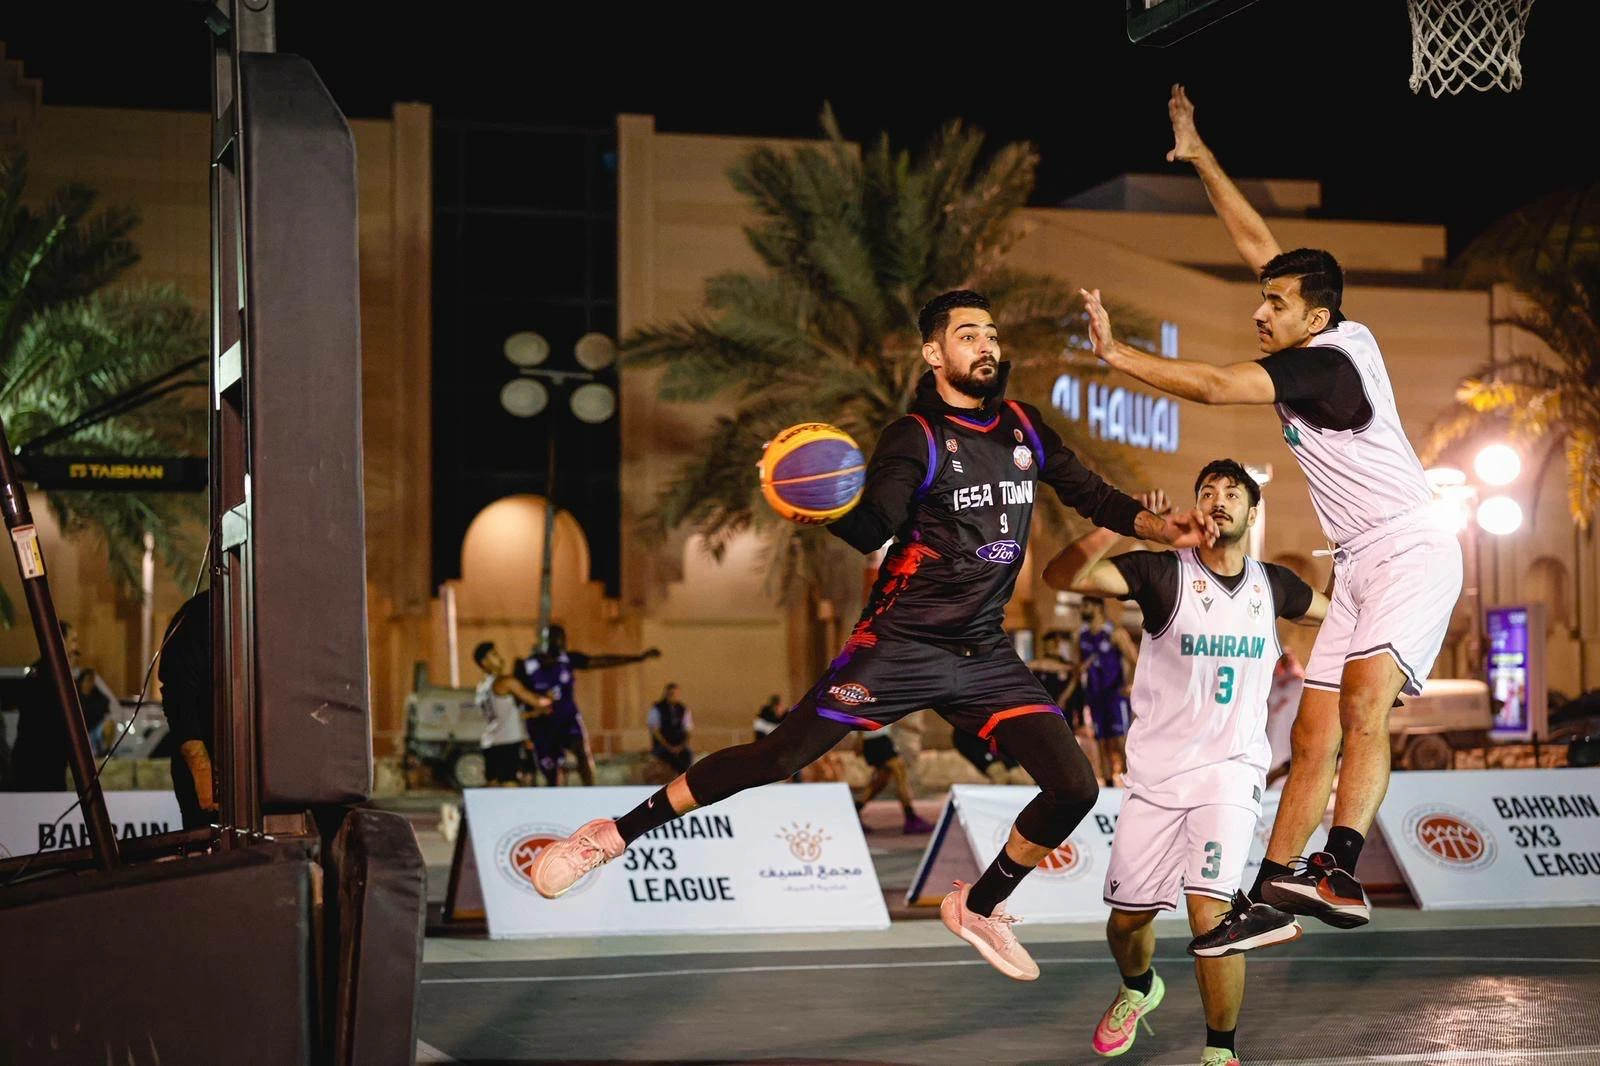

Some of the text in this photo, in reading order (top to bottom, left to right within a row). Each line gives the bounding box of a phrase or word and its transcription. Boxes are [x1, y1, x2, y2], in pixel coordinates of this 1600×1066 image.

[953, 480, 1034, 512] ISSA TOWN
[1000, 512, 1009, 534] 9
[1180, 633, 1265, 659] BAHRAIN
[1214, 666, 1235, 705] 3
[1492, 794, 1600, 819] BAHRAIN
[1508, 823, 1561, 848] 3X3
[623, 847, 677, 871] 3X3
[1201, 841, 1222, 879] 3
[1523, 852, 1600, 876] LEAGU
[628, 876, 735, 902] LEAGUE
